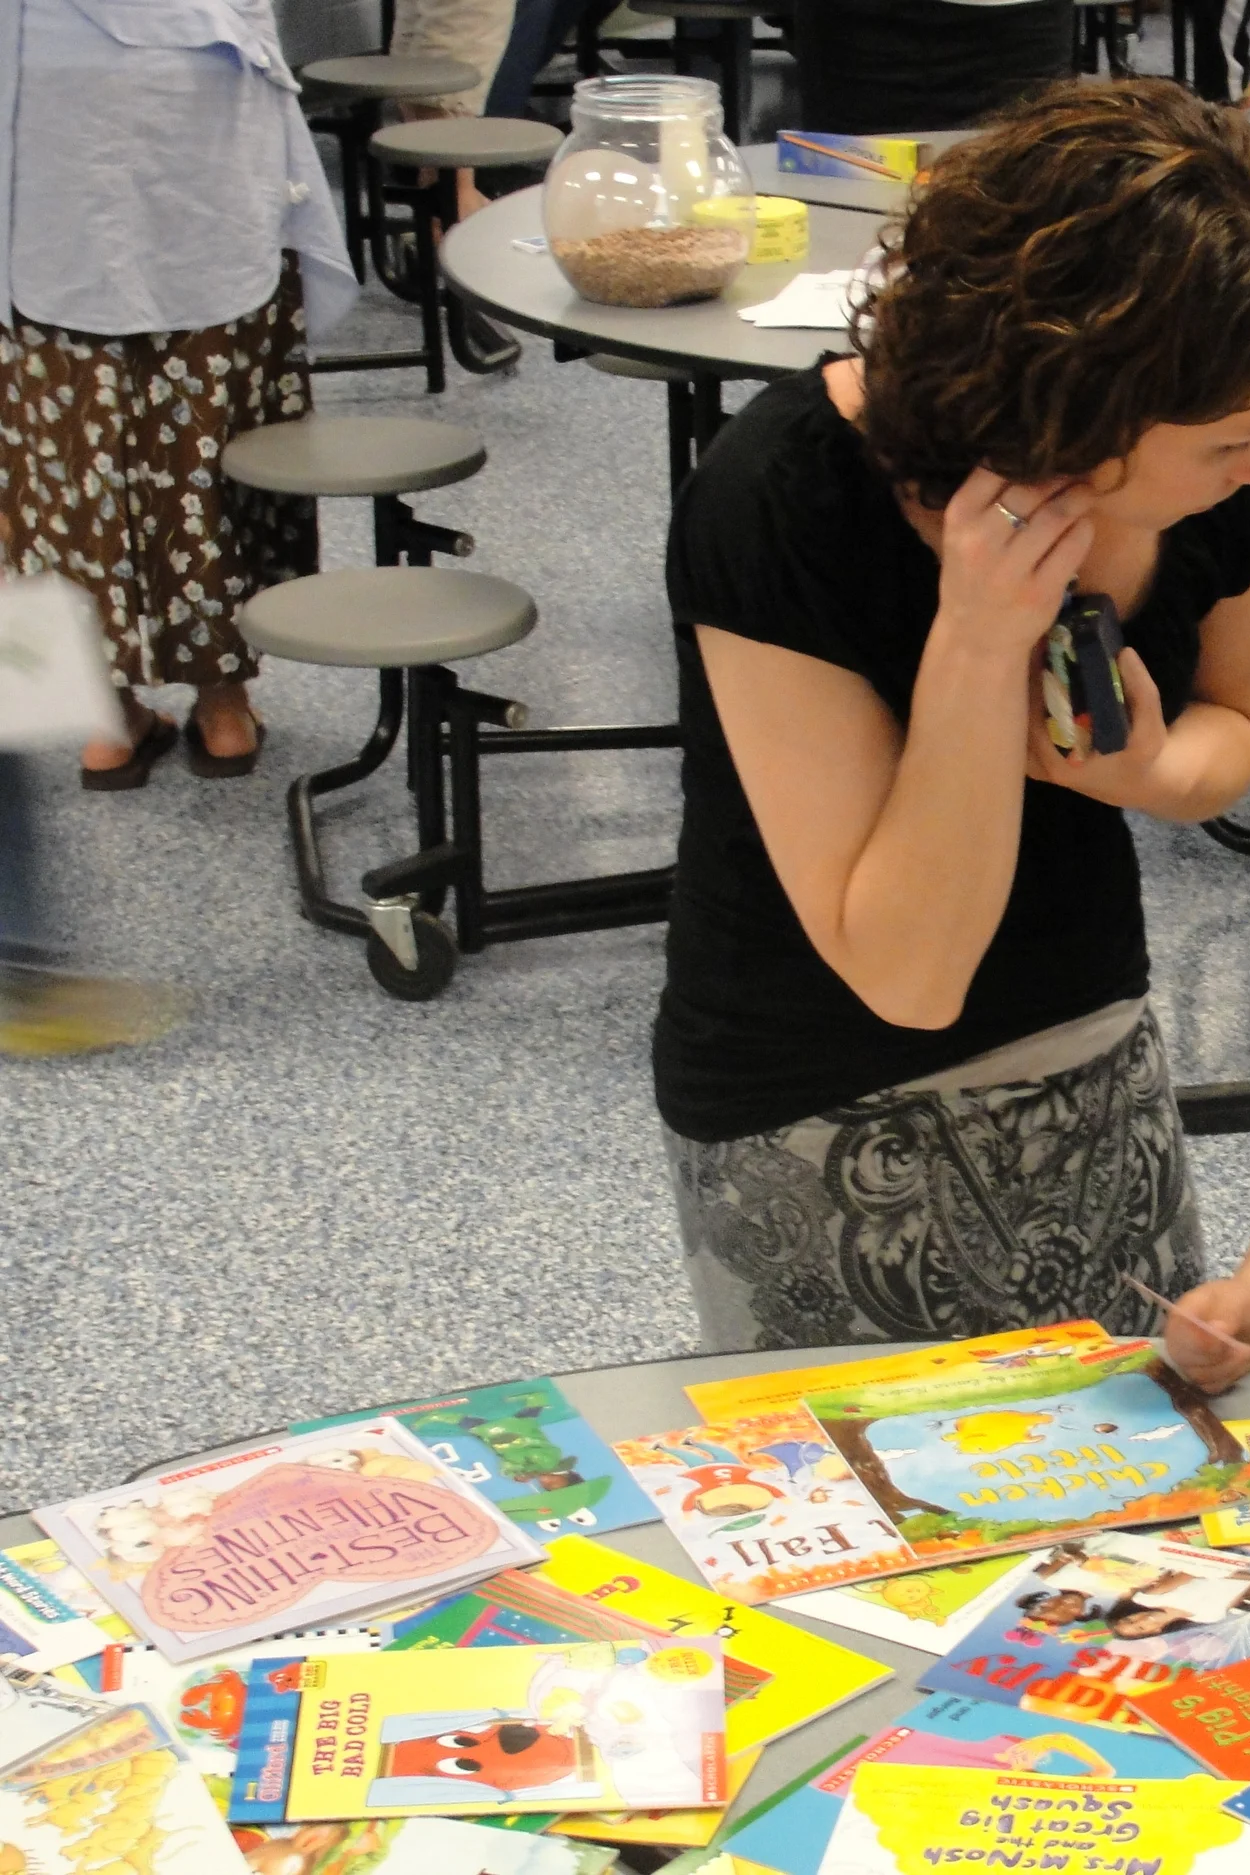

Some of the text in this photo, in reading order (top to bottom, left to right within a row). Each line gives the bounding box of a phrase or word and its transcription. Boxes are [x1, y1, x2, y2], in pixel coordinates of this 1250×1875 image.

[958, 1461, 1171, 1507] chicken
[969, 1443, 1128, 1480] little
[170, 1487, 440, 1582] VALENTINES
[726, 1521, 860, 1568] Fall
[169, 1512, 473, 1615] BEST THING
[582, 1575, 641, 1601] Cur
[312, 1700, 342, 1776] THE BIG
[340, 1692, 371, 1778] BAD COLD
[959, 1810, 1141, 1843] Great Big
[990, 1793, 1133, 1820] Squash
[995, 1836, 1097, 1851] and the
